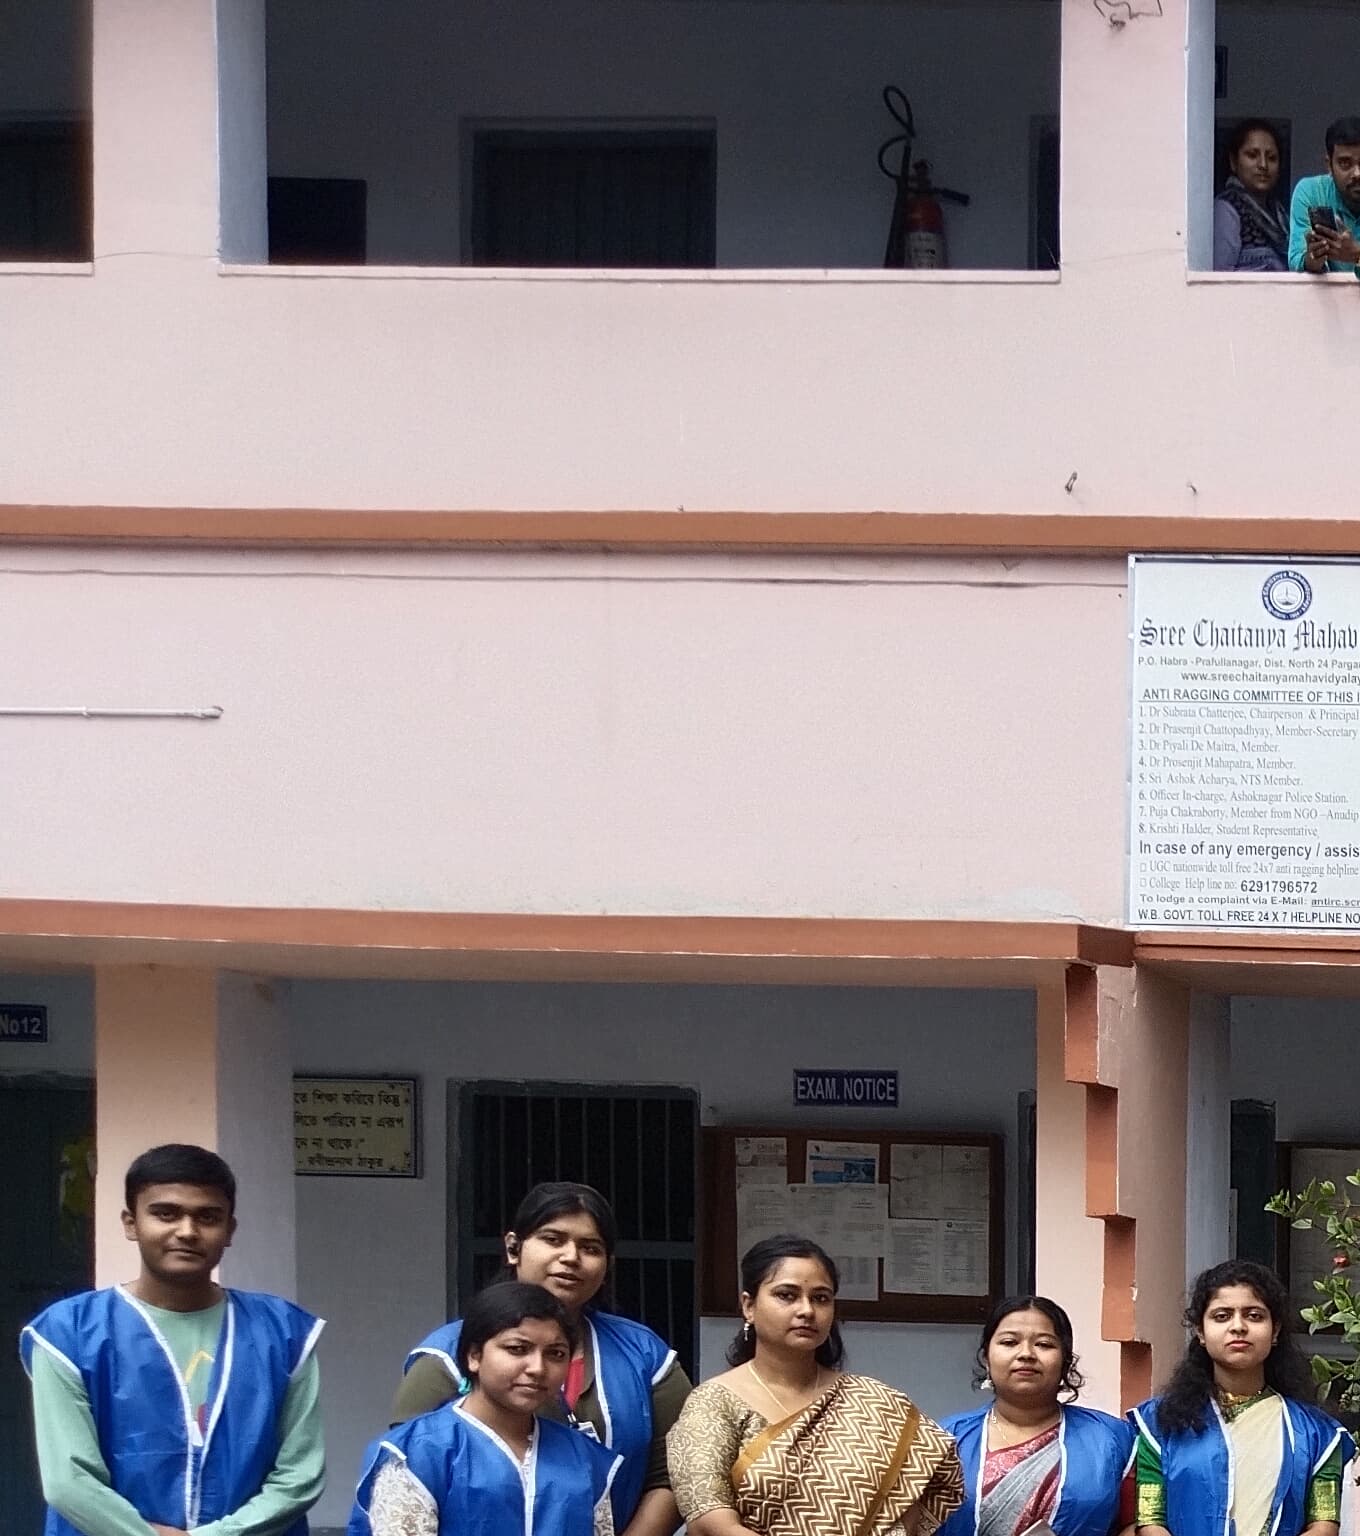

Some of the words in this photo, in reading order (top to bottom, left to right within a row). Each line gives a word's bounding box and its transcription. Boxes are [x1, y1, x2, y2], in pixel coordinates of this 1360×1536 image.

[1140, 617, 1186, 647] Sree
[1193, 618, 1286, 654] Chaitanya
[1160, 656, 1188, 666] Habra
[1288, 659, 1314, 669] North
[1317, 659, 1329, 669] 24
[1143, 688, 1170, 700] ANTI
[1174, 689, 1230, 701] RAGGING
[1233, 690, 1304, 702] COMMITTEE
[1307, 691, 1322, 703] OF
[1326, 691, 1353, 703] THIS
[1249, 708, 1303, 721] Chairperson
[1308, 709, 1317, 720] &
[1320, 709, 1360, 723] Principal
[1140, 840, 1151, 854] In
[1156, 843, 1186, 854] case
[1191, 841, 1205, 854] of
[1208, 844, 1232, 859] any
[1237, 844, 1311, 860] emergency
[1149, 861, 1171, 873] UGC
[1236, 861, 1251, 873] free
[1149, 878, 1180, 891] College
[1185, 878, 1205, 892] Help
[1207, 878, 1222, 889] line
[1241, 880, 1318, 894] 6291796572
[1140, 894, 1154, 903] To
[1157, 894, 1185, 905] lodge
[1188, 896, 1195, 904] a
[1198, 895, 1250, 906] complaint
[1253, 896, 1267, 905] via
[1138, 909, 1160, 920] W.B.
[1197, 909, 1225, 921] TOLL
[1227, 910, 1255, 922] FREE
[1258, 911, 1269, 922] 24
[1272, 911, 1279, 922] X
[1282, 911, 1288, 922] 7
[1291, 912, 1342, 923] HELPLINE
[797, 1077, 840, 1100] EXAM.
[843, 1077, 895, 1100] NOTICE
